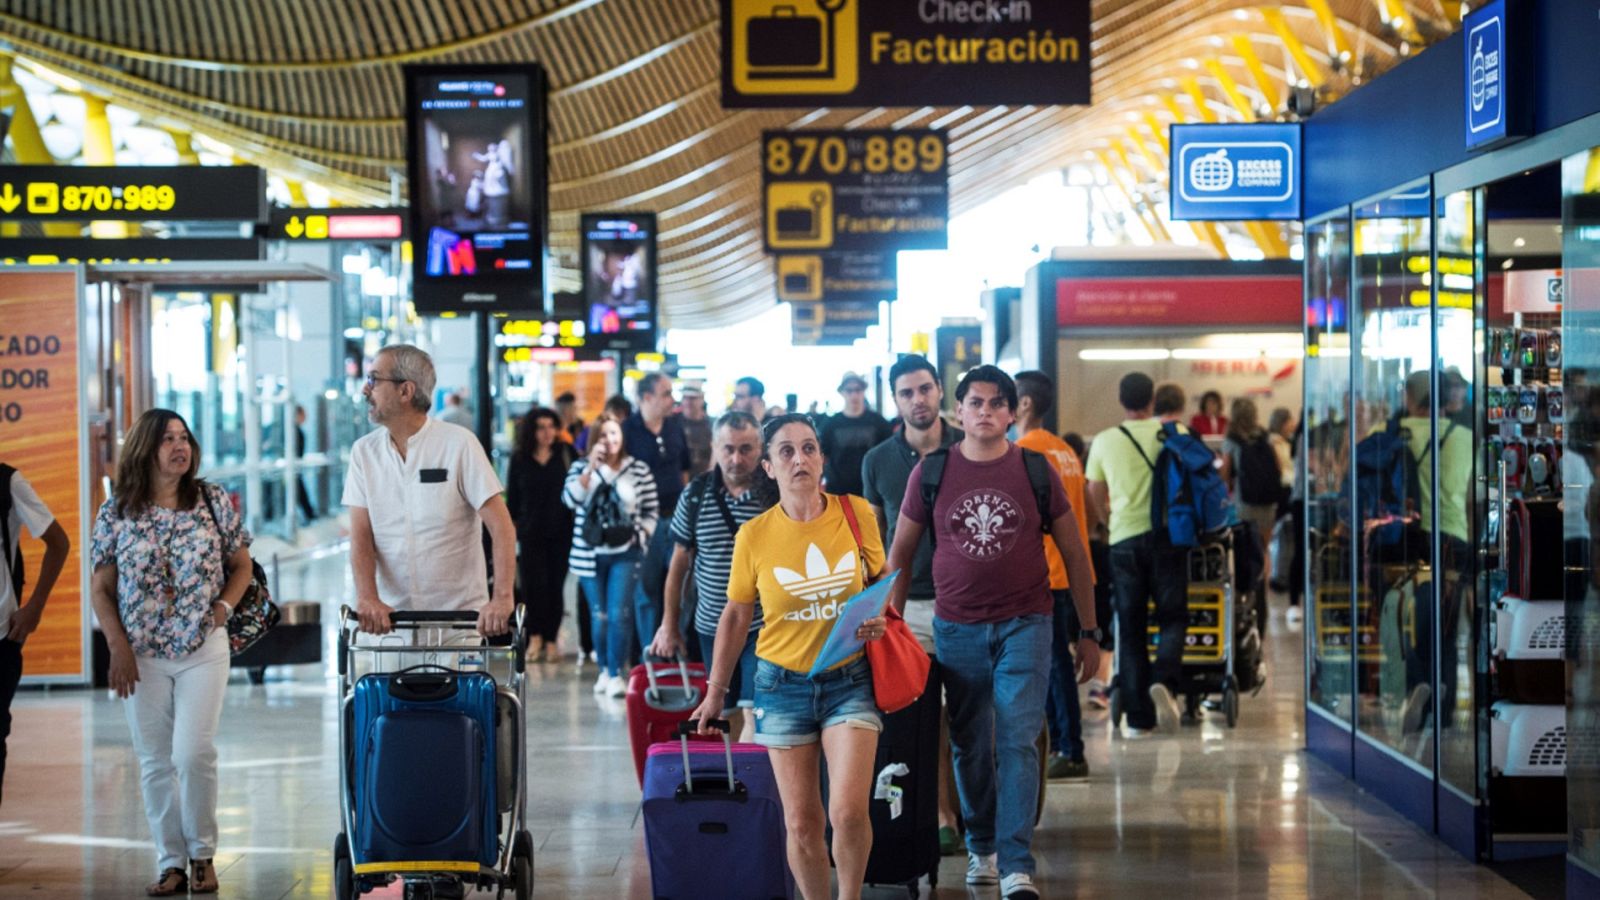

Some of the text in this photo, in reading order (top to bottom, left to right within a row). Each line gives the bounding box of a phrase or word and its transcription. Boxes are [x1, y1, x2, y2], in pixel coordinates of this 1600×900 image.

[918, 0, 1032, 23] Check-in
[870, 30, 1080, 64] Facturación
[767, 137, 848, 174] 870
[864, 135, 944, 173] 889
[62, 186, 113, 211] 870
[123, 185, 175, 211] 989
[836, 214, 944, 233] Facturación
[1191, 360, 1268, 375] IBERIA
[952, 494, 1016, 520] FLORENCE
[963, 541, 1002, 556] ITALY
